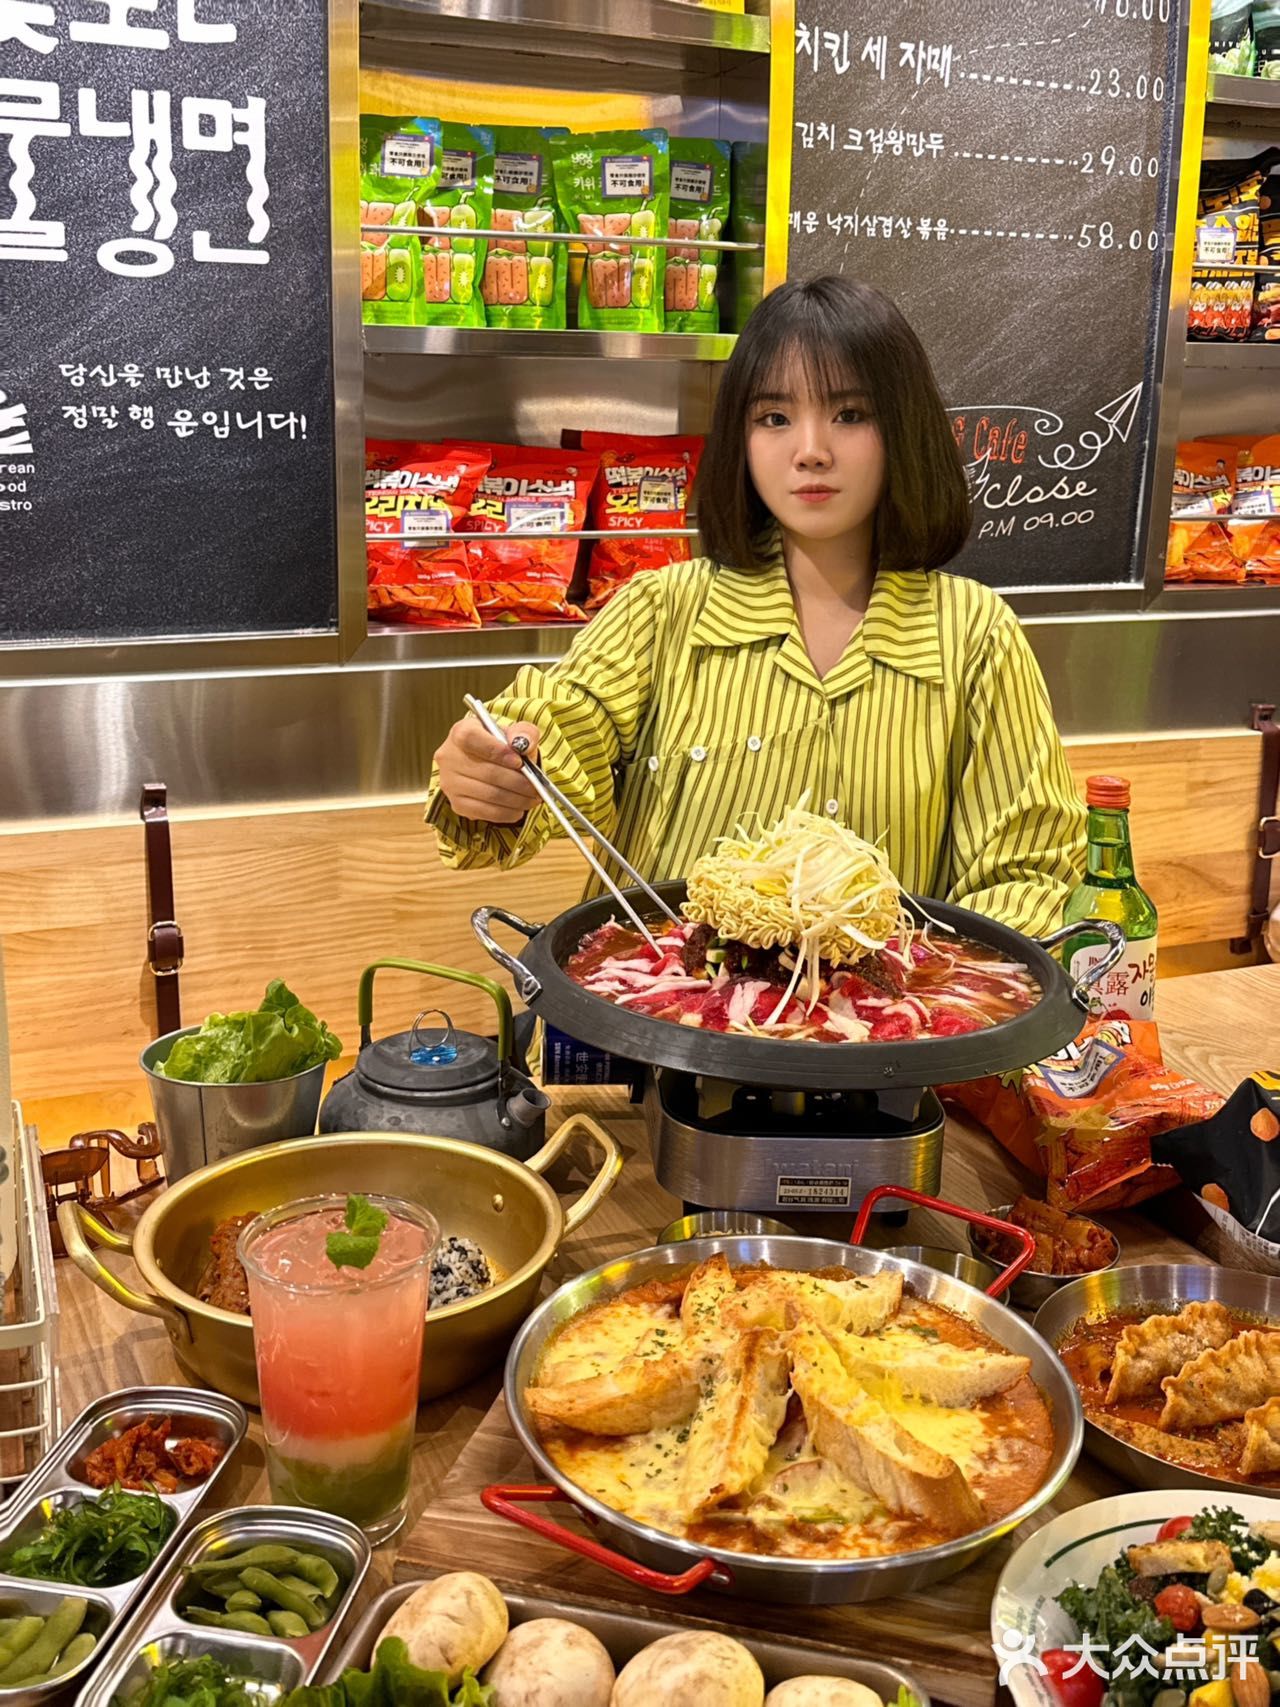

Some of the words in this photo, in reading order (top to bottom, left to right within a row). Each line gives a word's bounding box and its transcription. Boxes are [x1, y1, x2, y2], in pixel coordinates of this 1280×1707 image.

[795, 22, 850, 74] 치킨
[861, 35, 888, 80] 세
[899, 40, 953, 88] 자매
[1088, 68, 1165, 101] 23.00
[795, 121, 835, 151] 김치
[1080, 145, 1159, 178] 29.00
[827, 212, 912, 239] 낙지삼겹살
[916, 217, 949, 240] 볶음
[1077, 222, 1159, 251] 58.00
[59, 363, 144, 388] 당신을
[156, 366, 211, 389] 만난
[220, 366, 273, 391] 것은
[62, 404, 119, 429] 정말
[608, 515, 644, 527] SPICY
[1023, 509, 1095, 531] 09.00
